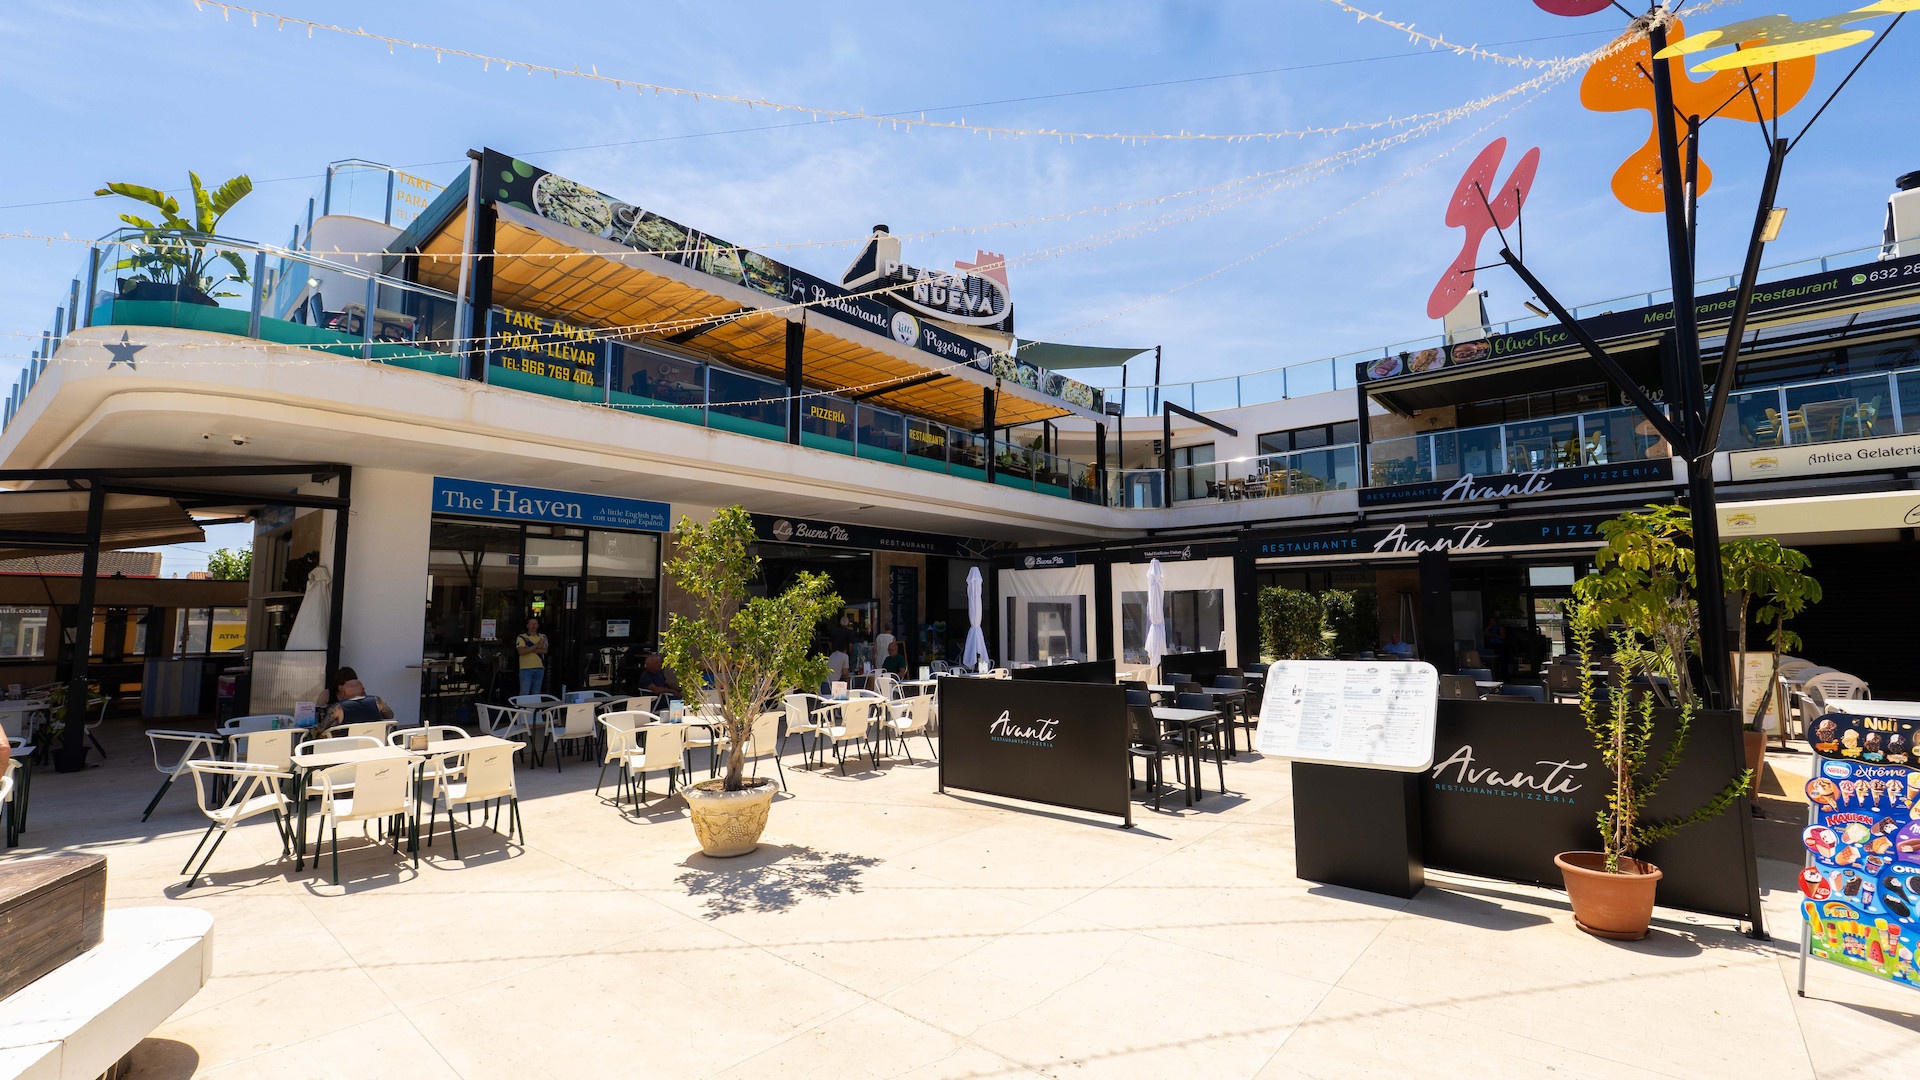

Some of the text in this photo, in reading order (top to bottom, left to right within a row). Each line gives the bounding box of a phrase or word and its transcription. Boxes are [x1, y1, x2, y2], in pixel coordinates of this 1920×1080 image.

[396, 171, 432, 192] TAKE
[397, 189, 428, 209] PARA
[885, 259, 965, 291] PLAZA
[1869, 268, 1898, 282] 632
[914, 284, 993, 315] NUEVA
[1750, 278, 1839, 304] Restaurant
[811, 285, 888, 328] Restaurante
[503, 308, 595, 344] TAKE AWAY
[502, 331, 595, 366] PARA LLEVAR
[923, 329, 969, 358] Pizzeria
[502, 356, 595, 386] TEL: 966 769 404
[909, 429, 945, 447] RESTAURANTE
[1808, 452, 1852, 466] Antica
[1366, 466, 1660, 502] RESTAURANTE Avanti PIZZERIA
[442, 488, 582, 520] The Haven
[607, 508, 623, 517] little
[625, 510, 650, 520] English
[618, 517, 637, 525] toque
[773, 521, 935, 550] La Buena Pita RESTAURANTE
[1262, 538, 1358, 553] RESTAURANTE
[1373, 521, 1494, 554] Avanti
[990, 709, 1060, 743] Avanti
[1432, 745, 1588, 794] Avanti
[1825, 812, 1873, 827] MAXIBON
